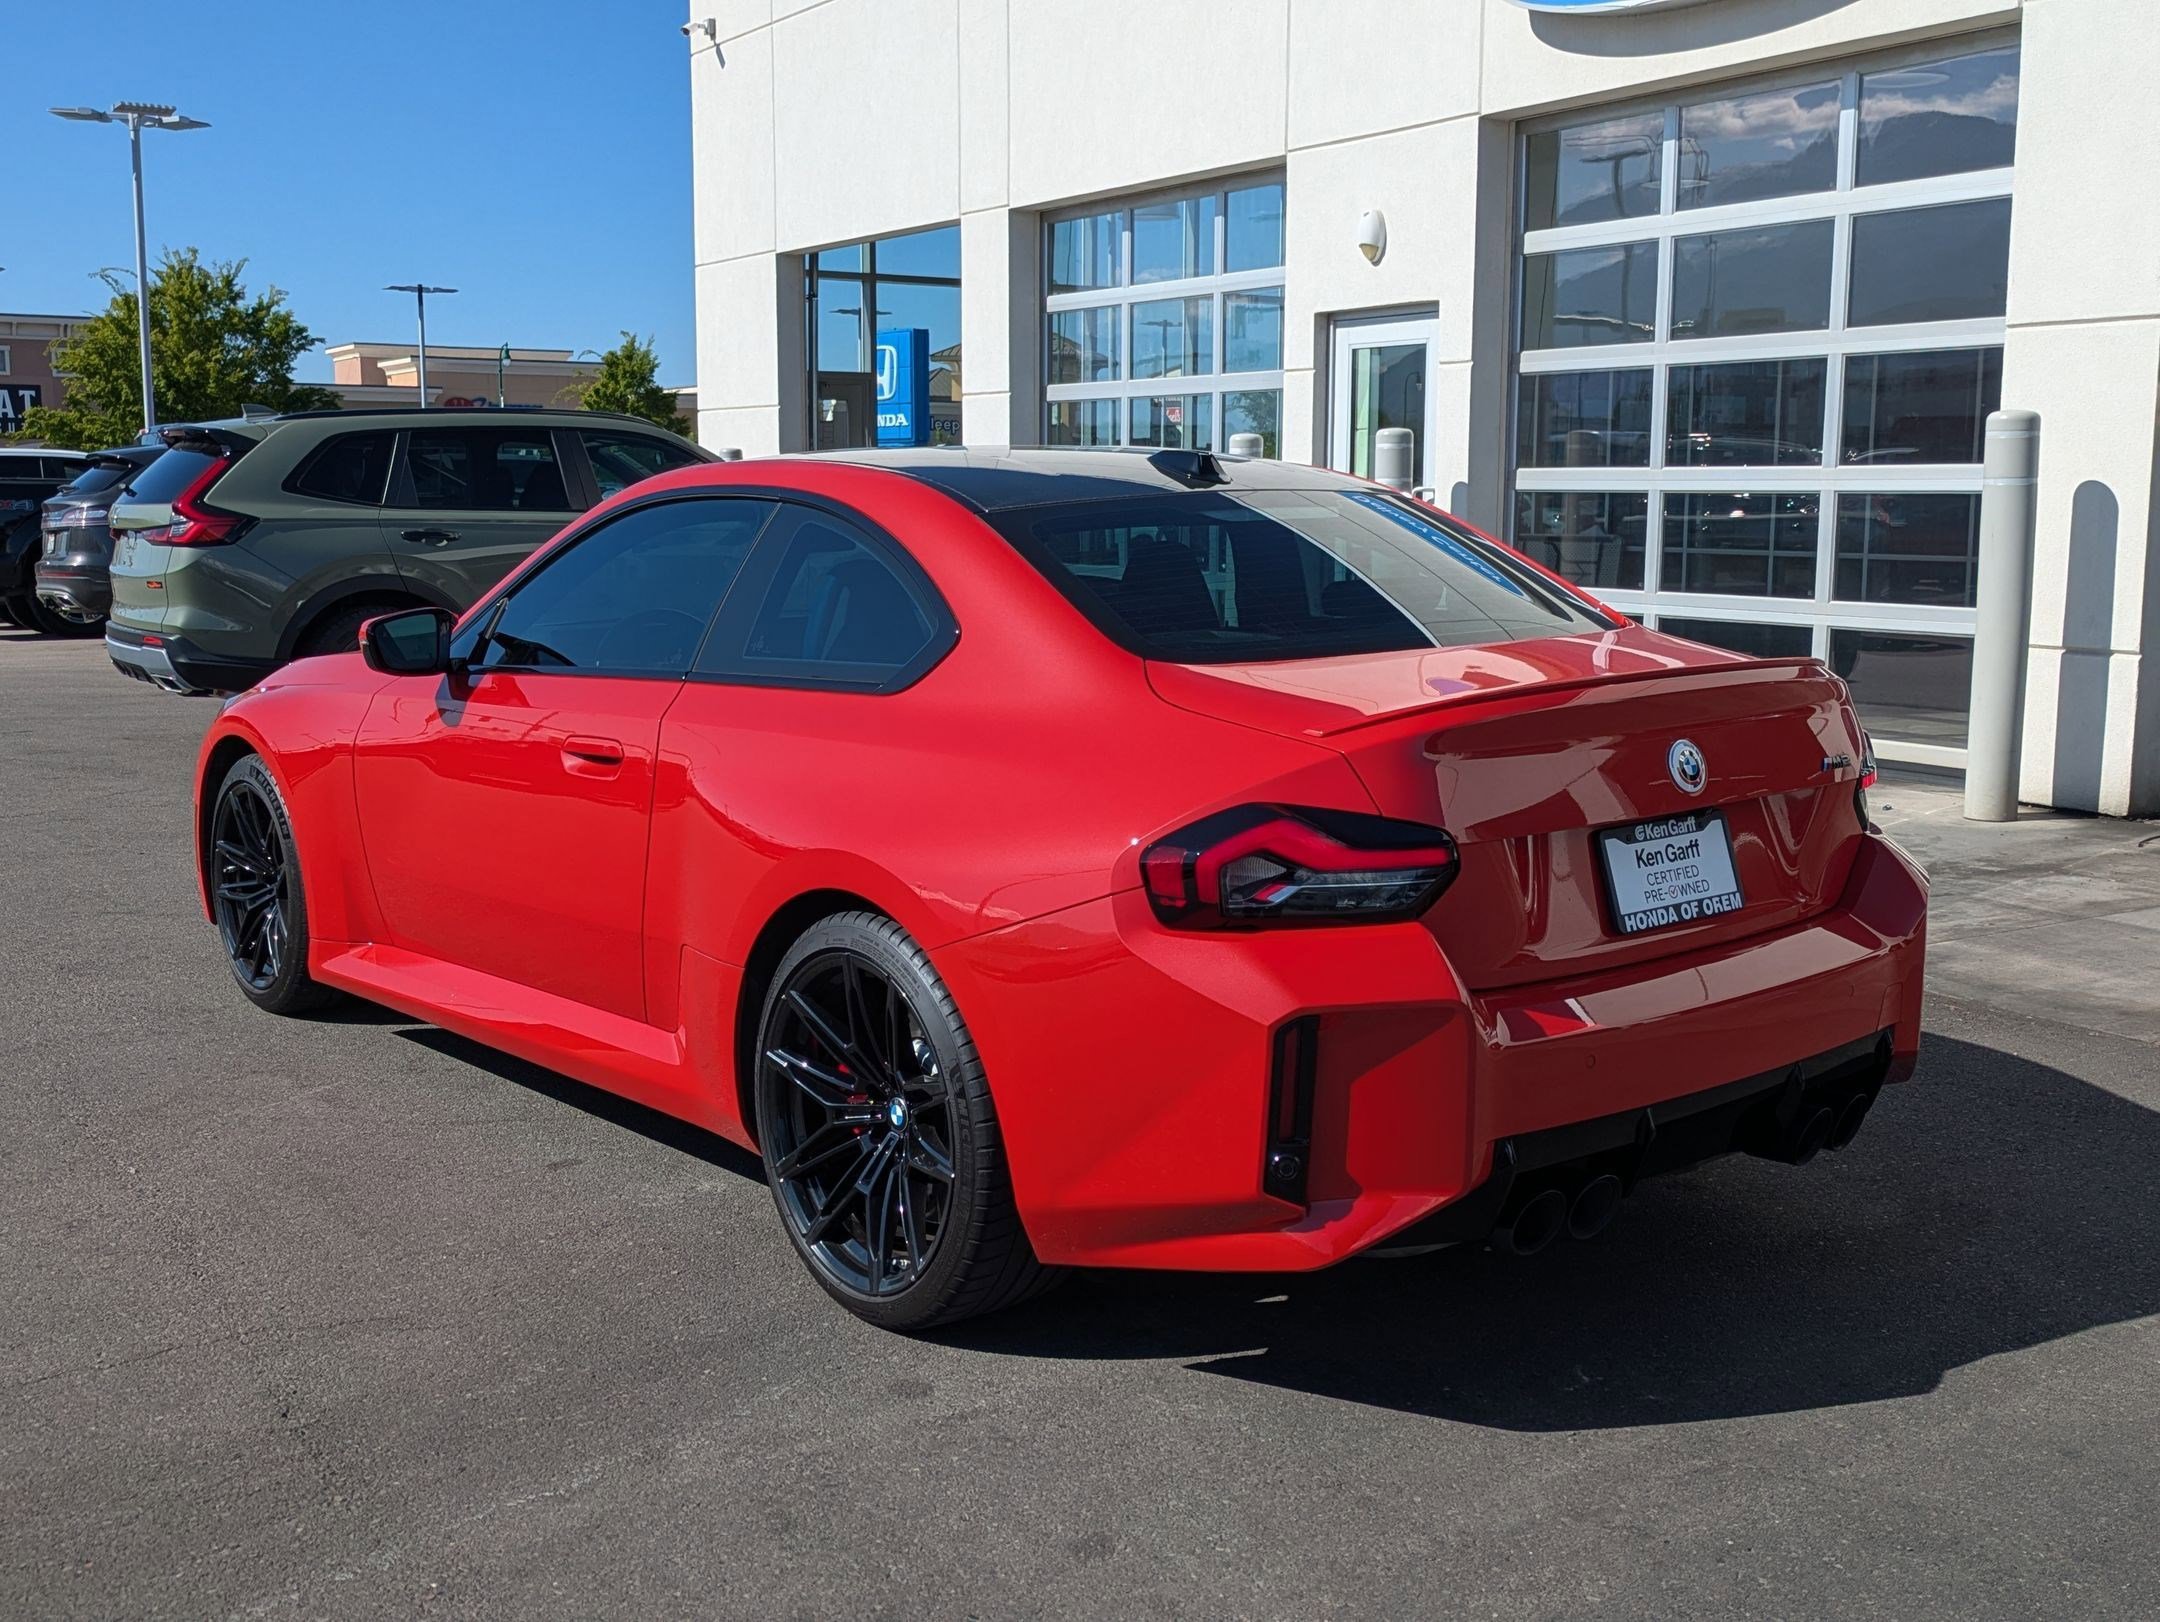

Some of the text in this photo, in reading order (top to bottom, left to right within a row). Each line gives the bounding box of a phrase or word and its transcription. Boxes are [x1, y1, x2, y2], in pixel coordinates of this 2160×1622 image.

[877, 413, 908, 428] NDA
[1645, 816, 1697, 838] Ken Garff
[1635, 839, 1701, 868] Ken Garff
[1646, 864, 1700, 886] CERTIFIED
[1624, 892, 1743, 932] HONDA OF OREM
